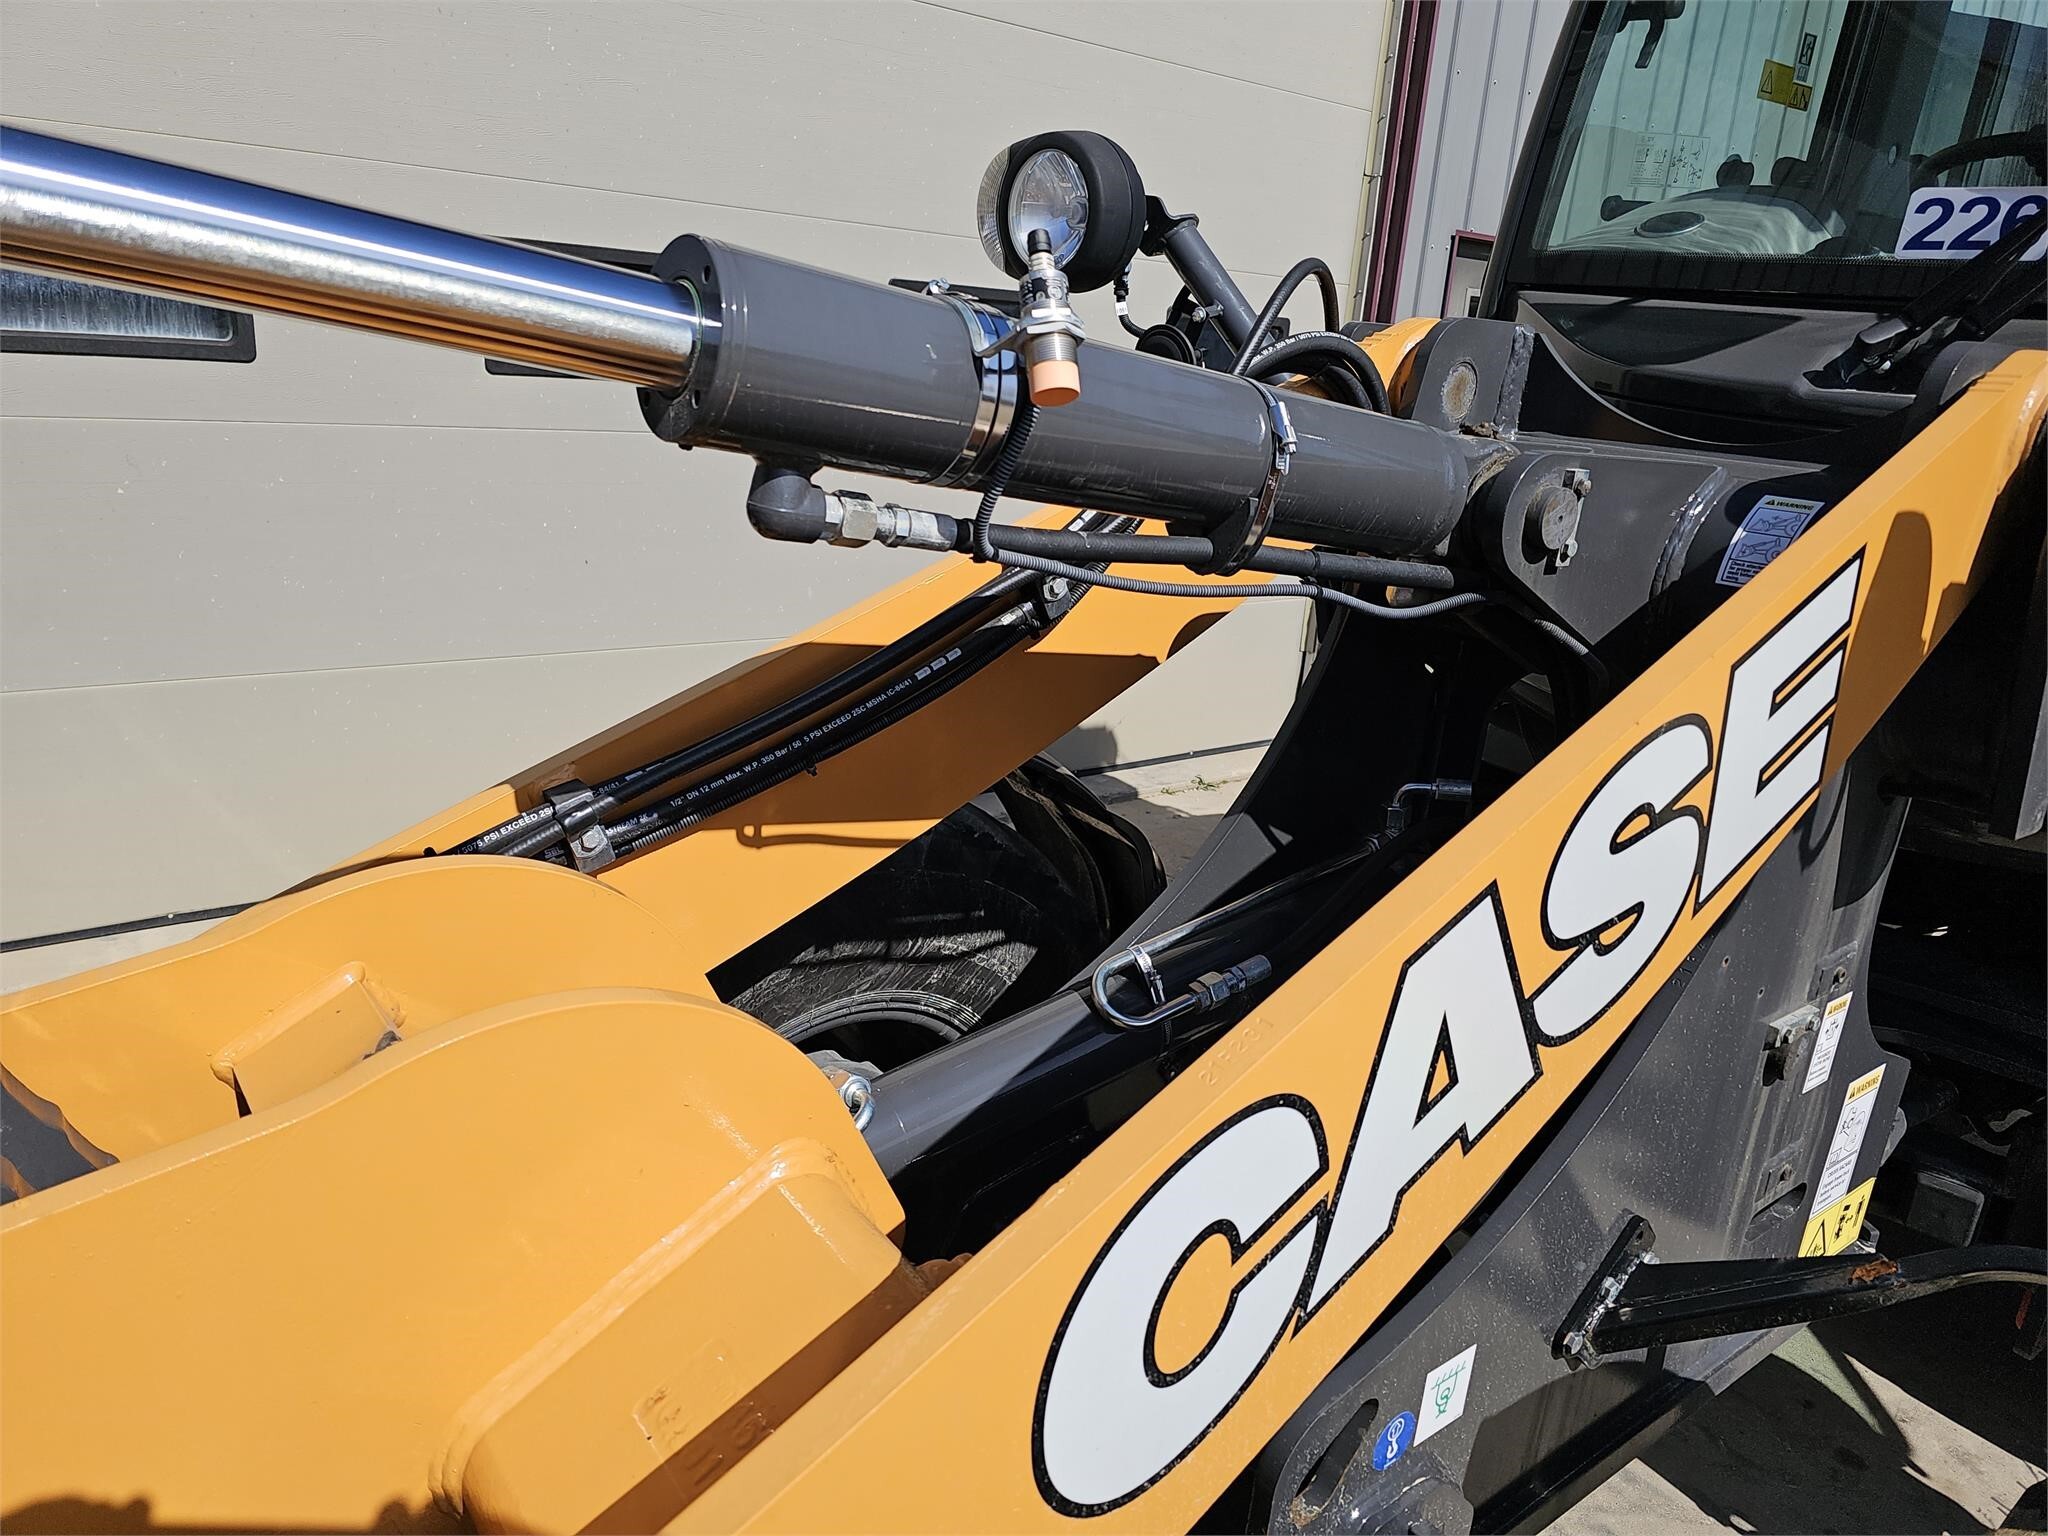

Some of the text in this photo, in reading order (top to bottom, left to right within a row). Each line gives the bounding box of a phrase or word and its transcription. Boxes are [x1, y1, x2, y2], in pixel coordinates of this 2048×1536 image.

[1776, 501, 1814, 511] WARNING
[686, 790, 699, 800] DN
[700, 785, 709, 794] 12
[710, 779, 724, 789] mm
[725, 771, 743, 781] Max.
[743, 762, 760, 772] W.P.
[761, 754, 774, 764] 350
[775, 748, 788, 757] Bar
[809, 729, 822, 739] PSI
[823, 714, 851, 732] EXCEED
[852, 705, 866, 716] 2SC
[866, 694, 886, 709] MSHA
[484, 831, 500, 843] PSI
[500, 813, 538, 834] EXCEED
[1031, 545, 1869, 1518] CASE
[1855, 1075, 1880, 1096] WARNING
